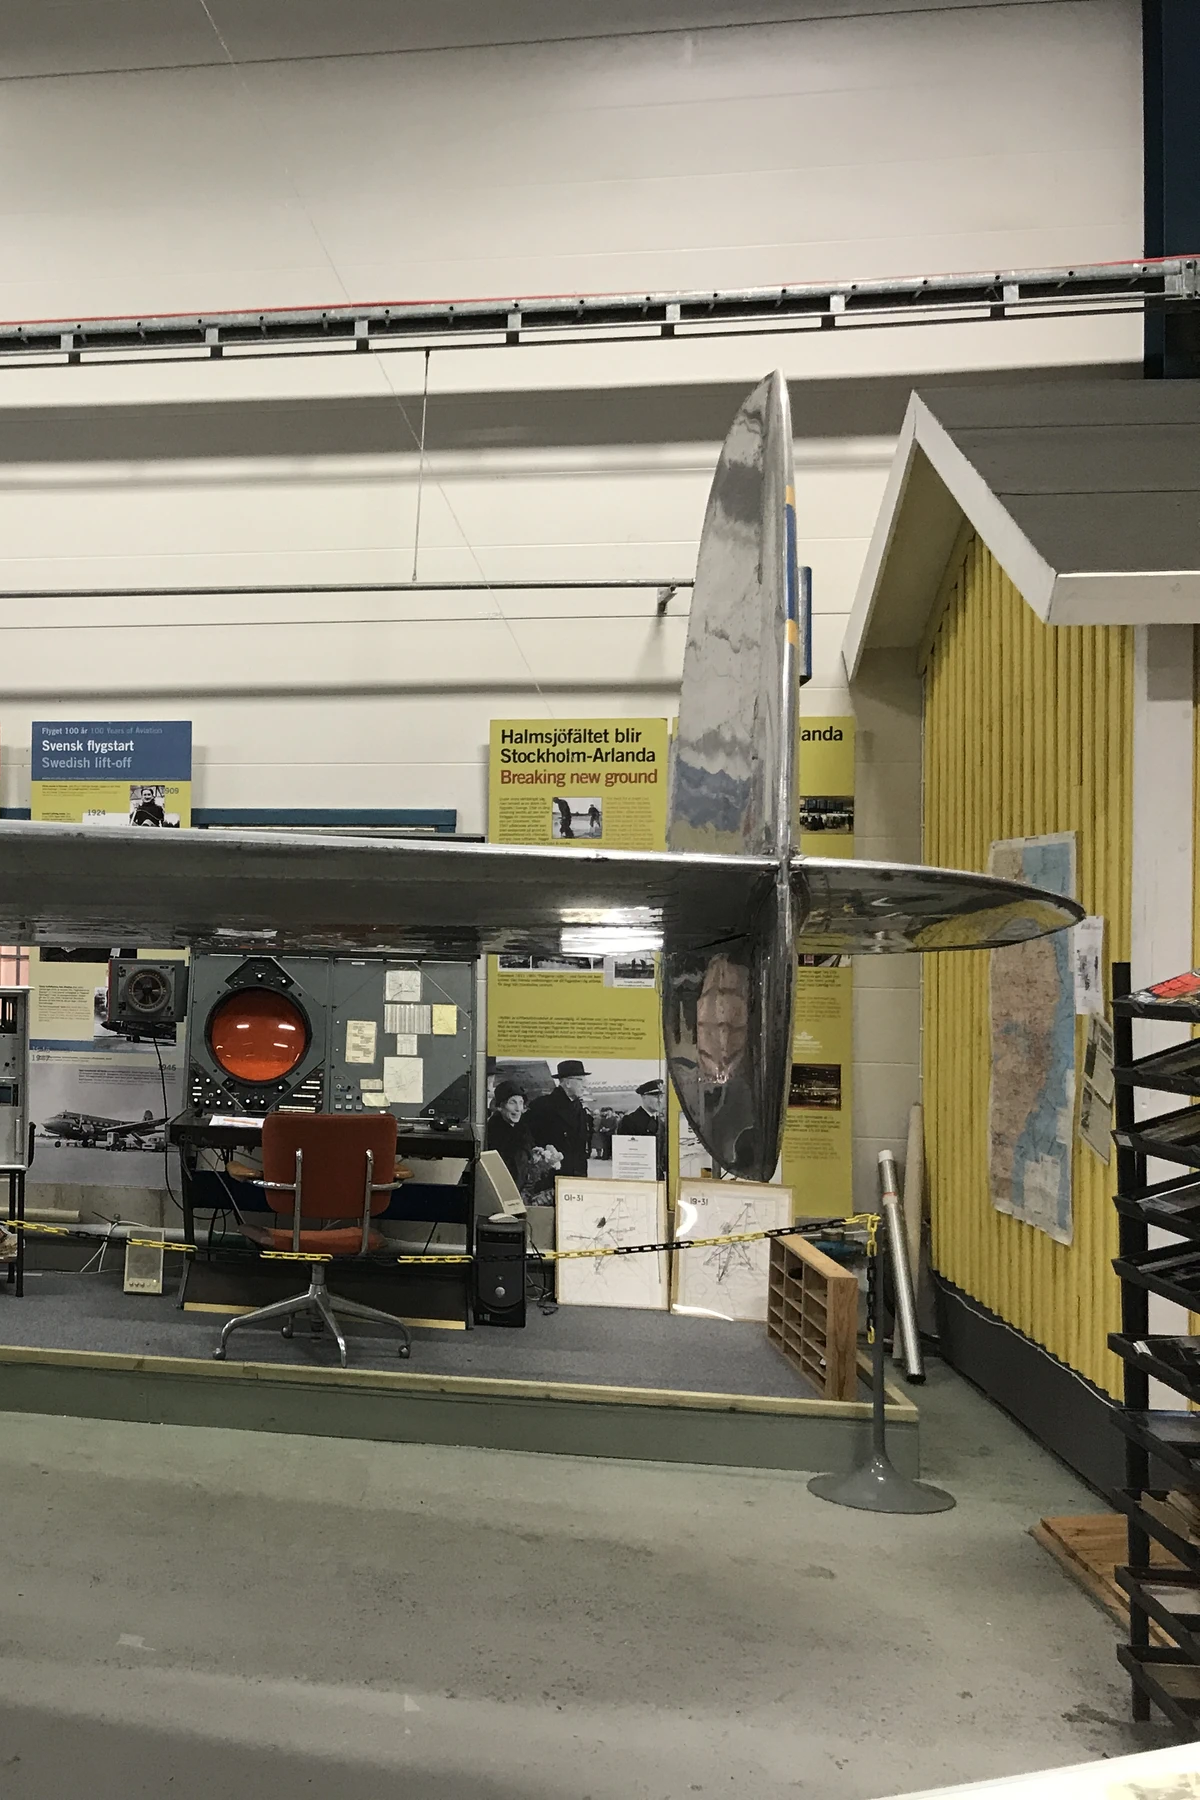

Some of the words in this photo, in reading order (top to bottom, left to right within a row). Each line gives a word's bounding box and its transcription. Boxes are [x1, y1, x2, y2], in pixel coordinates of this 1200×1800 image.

[41, 727, 62, 736] Flyget
[64, 727, 79, 735] 100
[80, 726, 88, 735] år
[91, 727, 104, 735] 100
[126, 726, 133, 735] of
[501, 728, 610, 747] Halmsjöfältet
[614, 728, 642, 743] blir
[799, 726, 844, 742] anda
[42, 740, 84, 752] Svensk
[87, 740, 135, 754] flygstart
[42, 757, 91, 769] Swedish
[94, 757, 133, 769] lift-off
[500, 747, 656, 764] Stockholm-Arlanda
[500, 769, 567, 787] Breaking
[570, 772, 601, 784] new
[604, 769, 658, 787] ground
[87, 809, 106, 817] 1924
